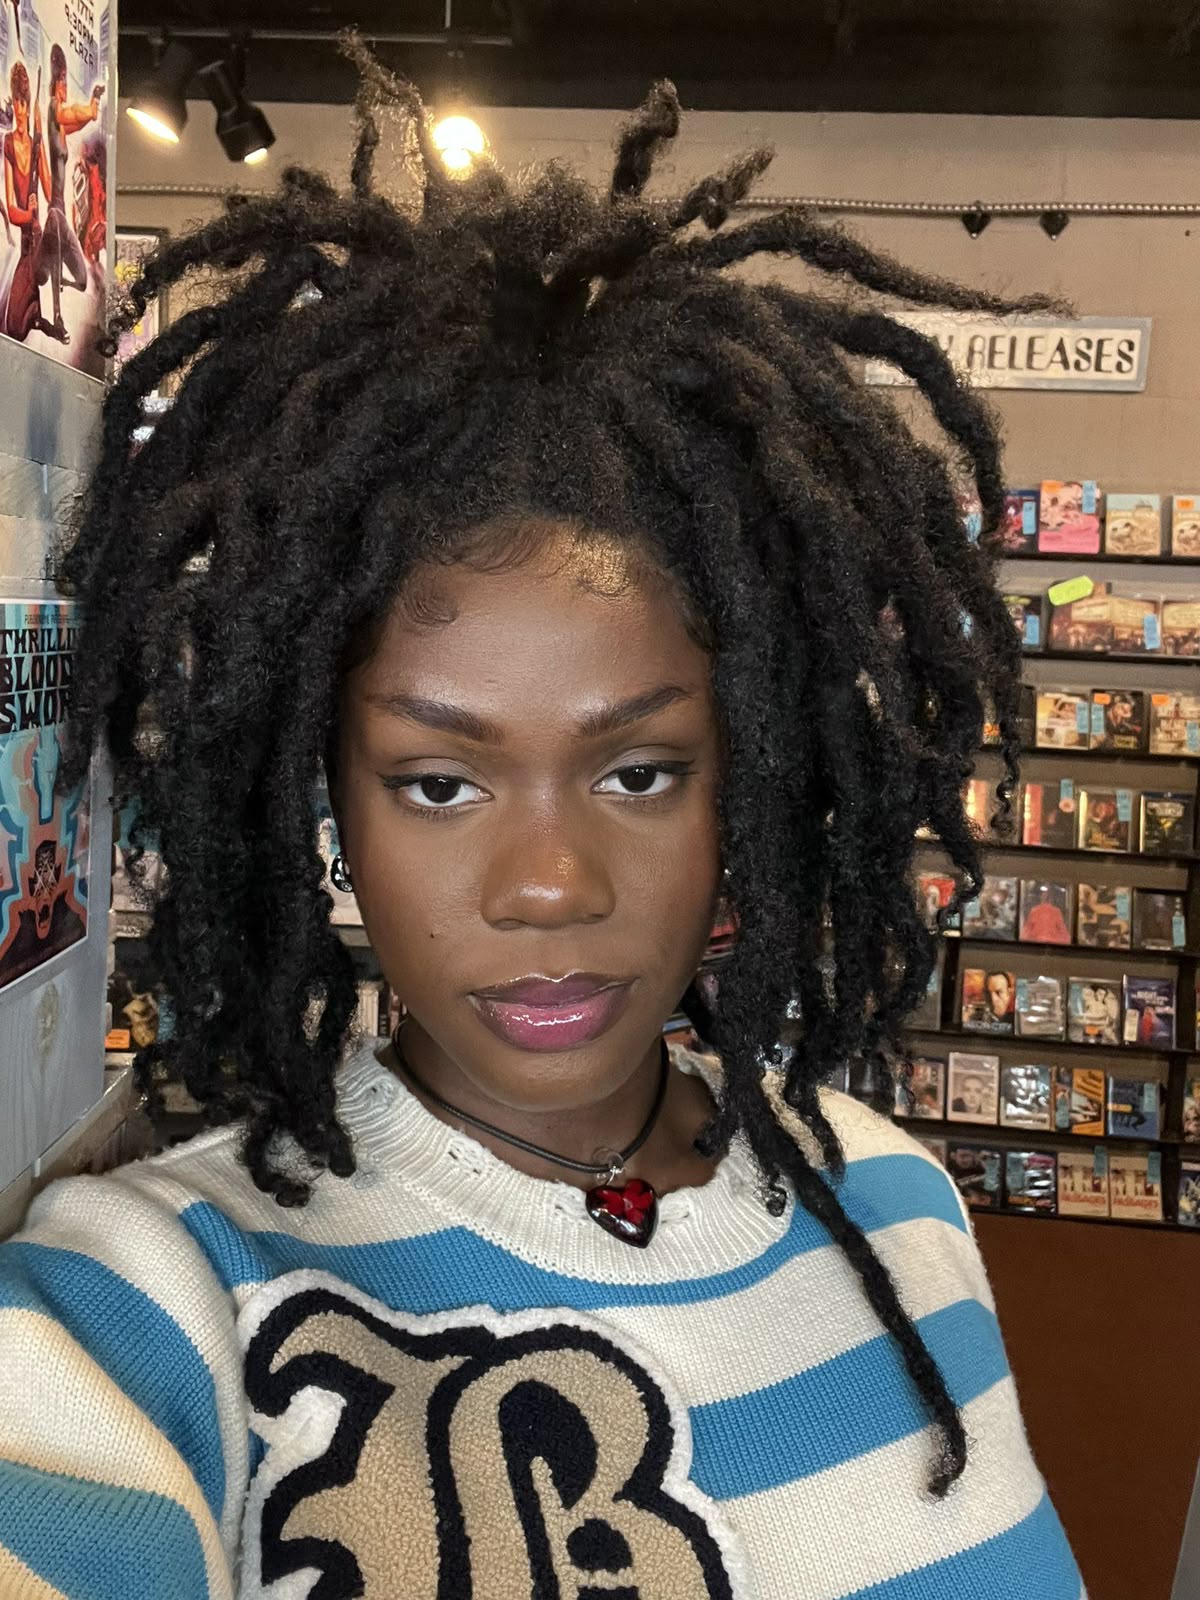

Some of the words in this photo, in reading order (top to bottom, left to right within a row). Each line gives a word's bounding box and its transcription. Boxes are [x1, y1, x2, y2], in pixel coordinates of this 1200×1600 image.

[69, 30, 94, 70] PLAZA
[966, 334, 1135, 374] RELEASES
[0, 628, 80, 656] THRILLI
